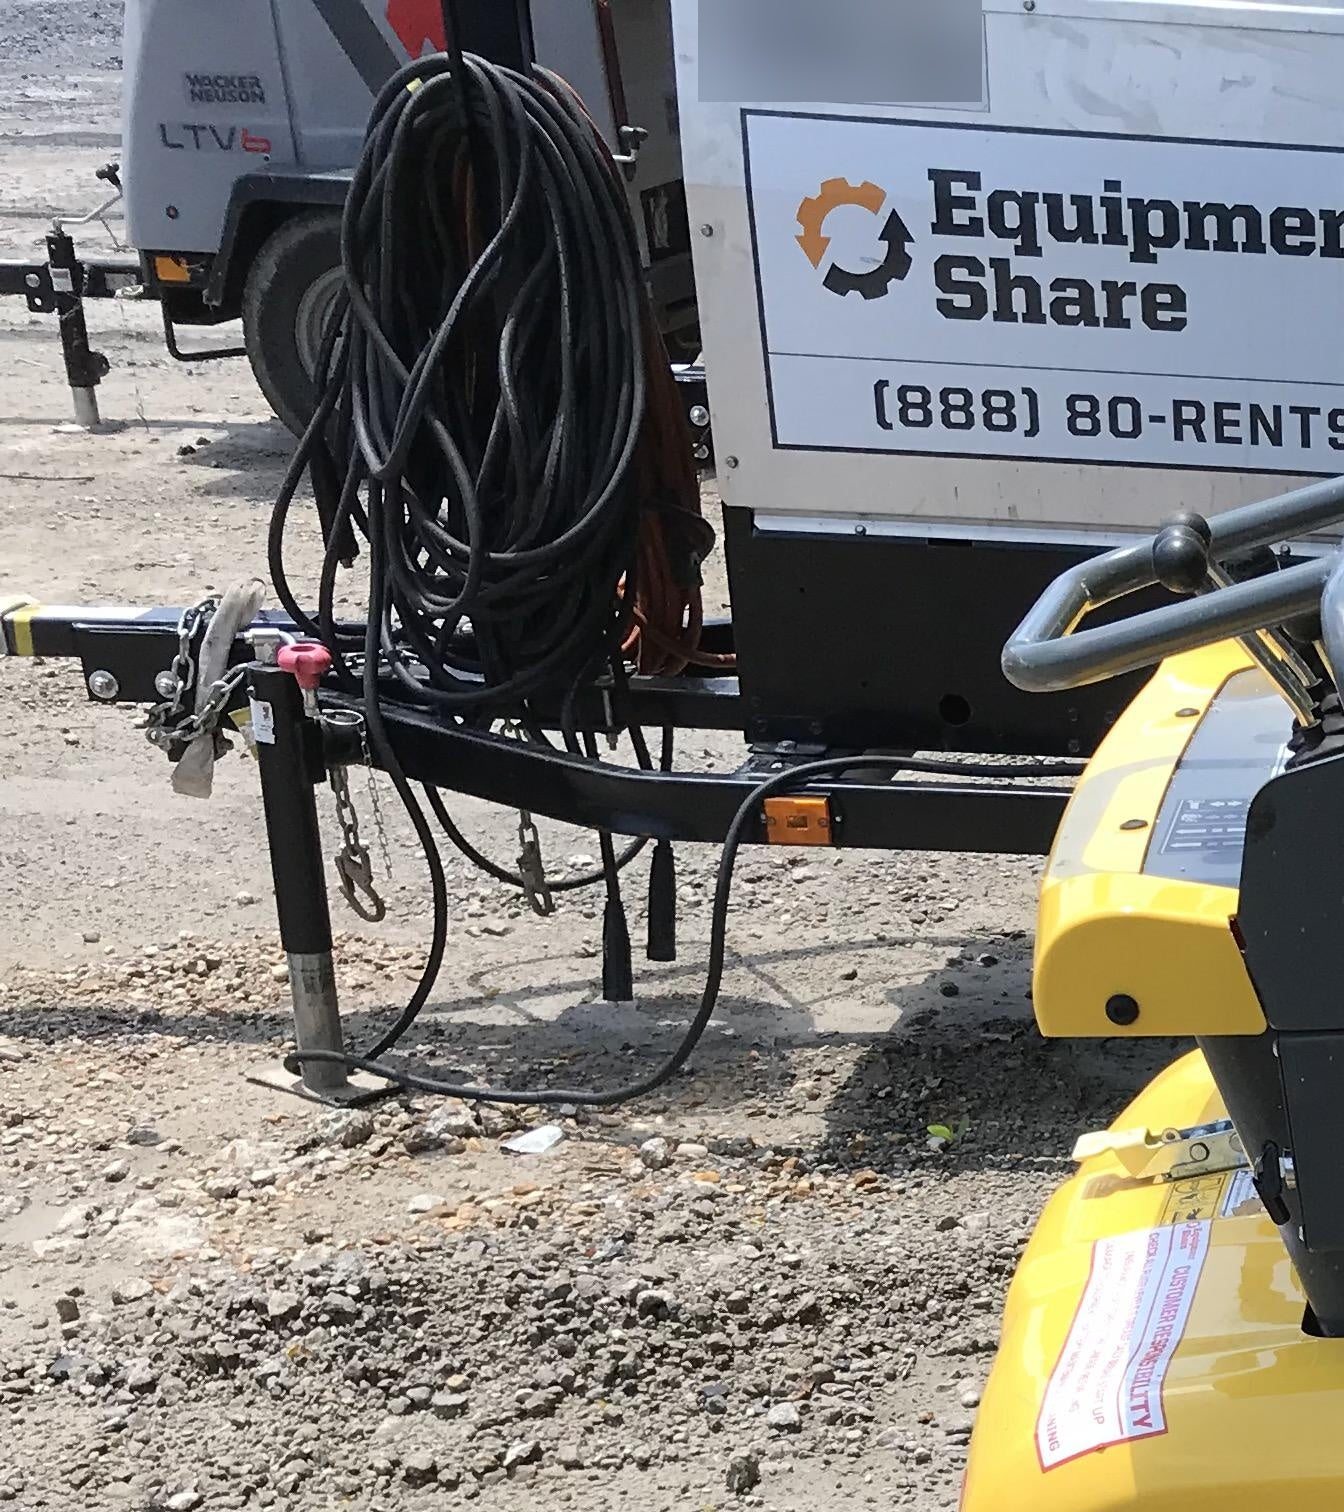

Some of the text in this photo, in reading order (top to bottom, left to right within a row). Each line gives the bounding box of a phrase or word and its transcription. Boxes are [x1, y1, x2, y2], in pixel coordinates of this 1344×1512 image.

[184, 72, 263, 90] WACKER
[190, 88, 266, 104] NEUSON
[933, 254, 1188, 332] Share
[873, 378, 1040, 437] (888)
[1128, 1265, 1191, 1429] CUSTOMER RESPONSIBILITY
[1092, 1407, 1105, 1425] UP
